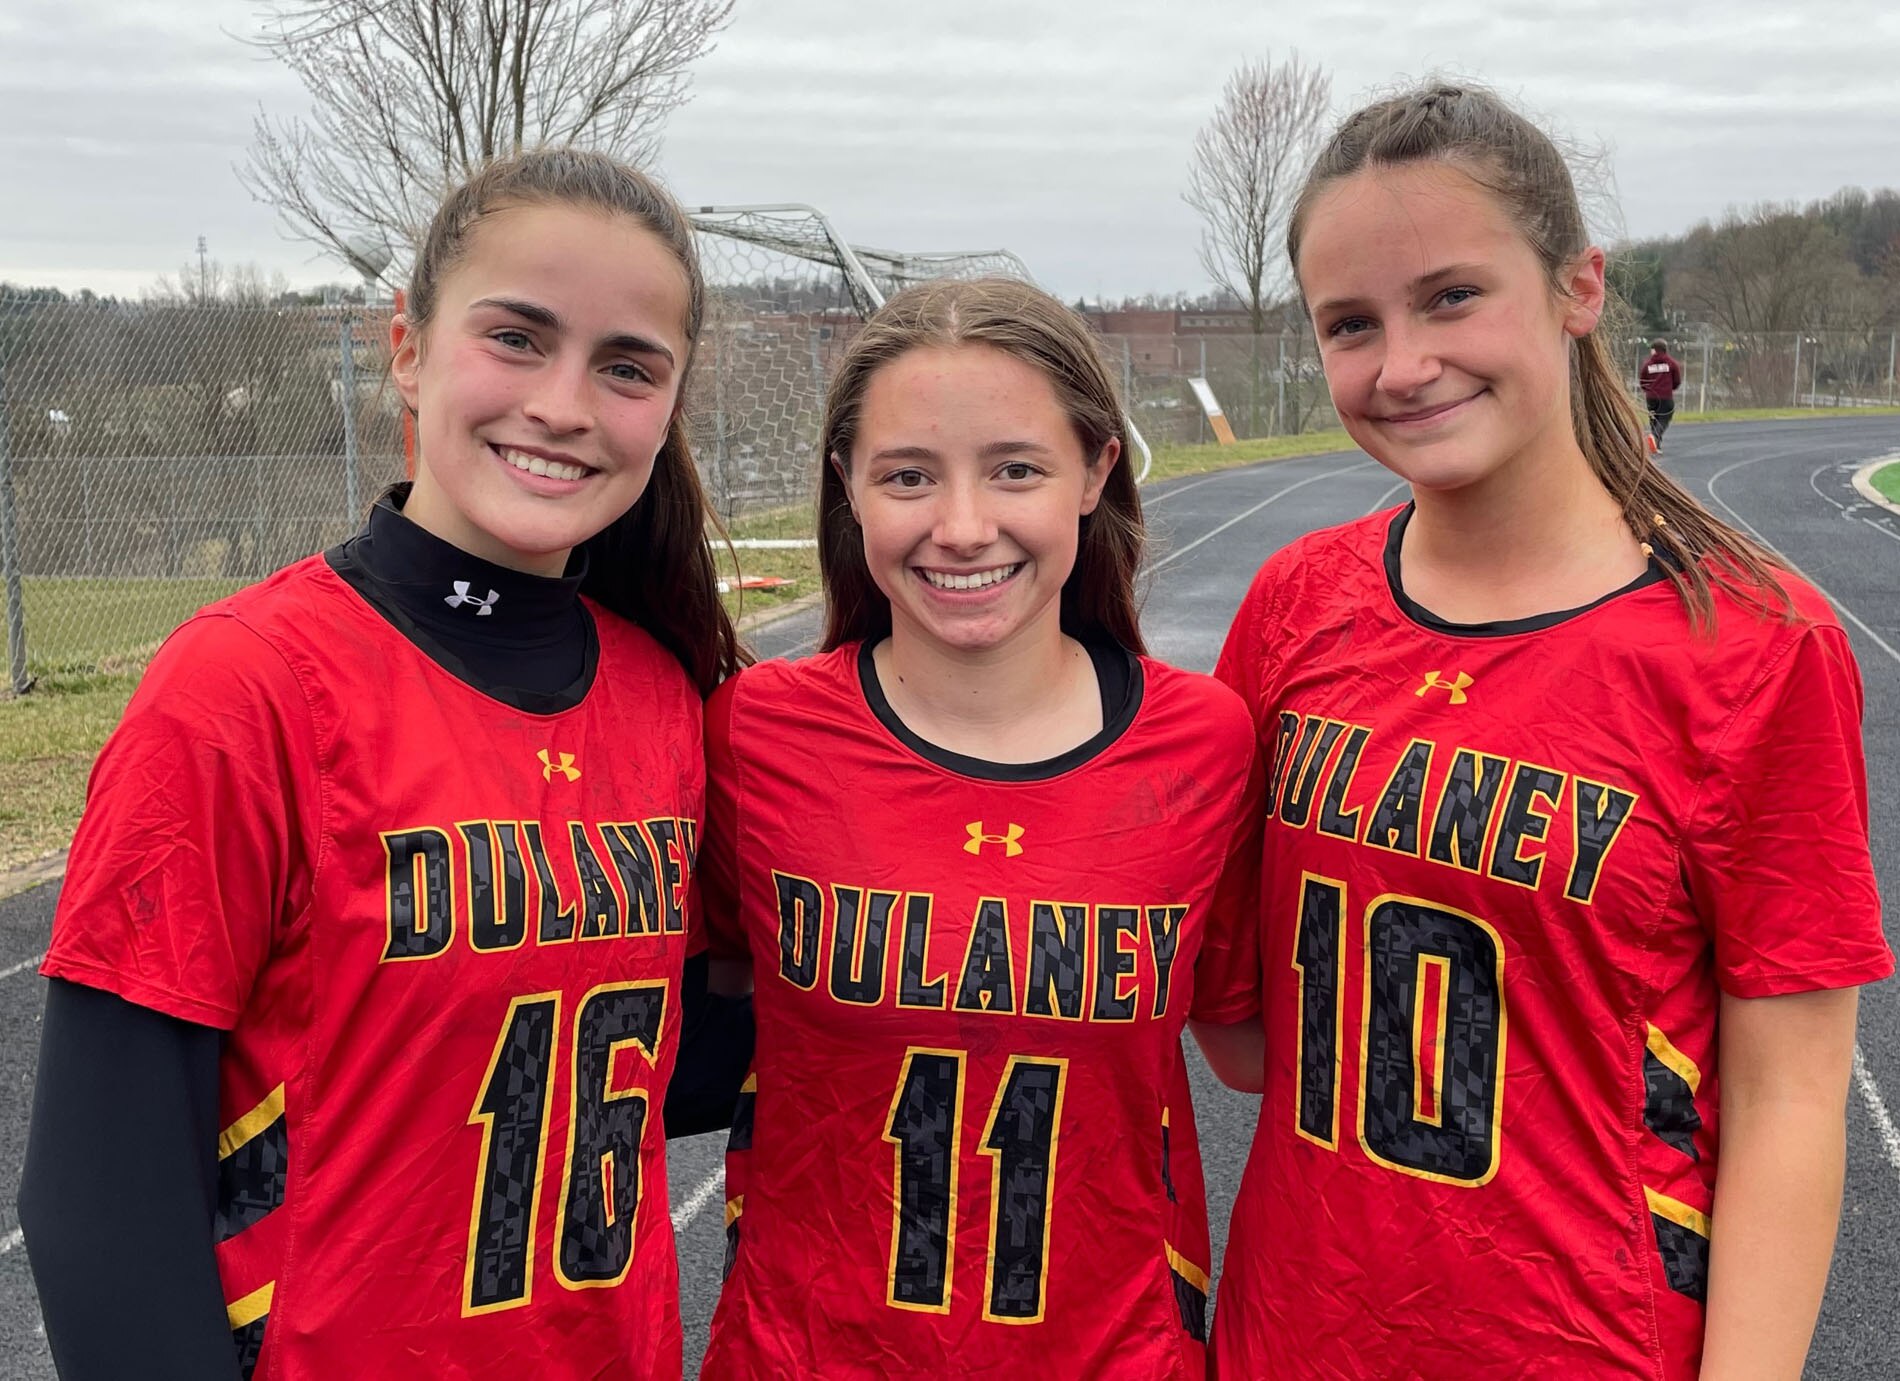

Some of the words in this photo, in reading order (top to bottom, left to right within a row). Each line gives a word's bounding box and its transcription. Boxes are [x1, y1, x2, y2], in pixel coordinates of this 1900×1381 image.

[771, 869, 1190, 1023] DULANEY
[1266, 710, 1640, 905] DULANEY
[461, 978, 669, 1318] 16
[1291, 870, 1508, 1188] 10
[881, 1045, 1069, 1325] 11
